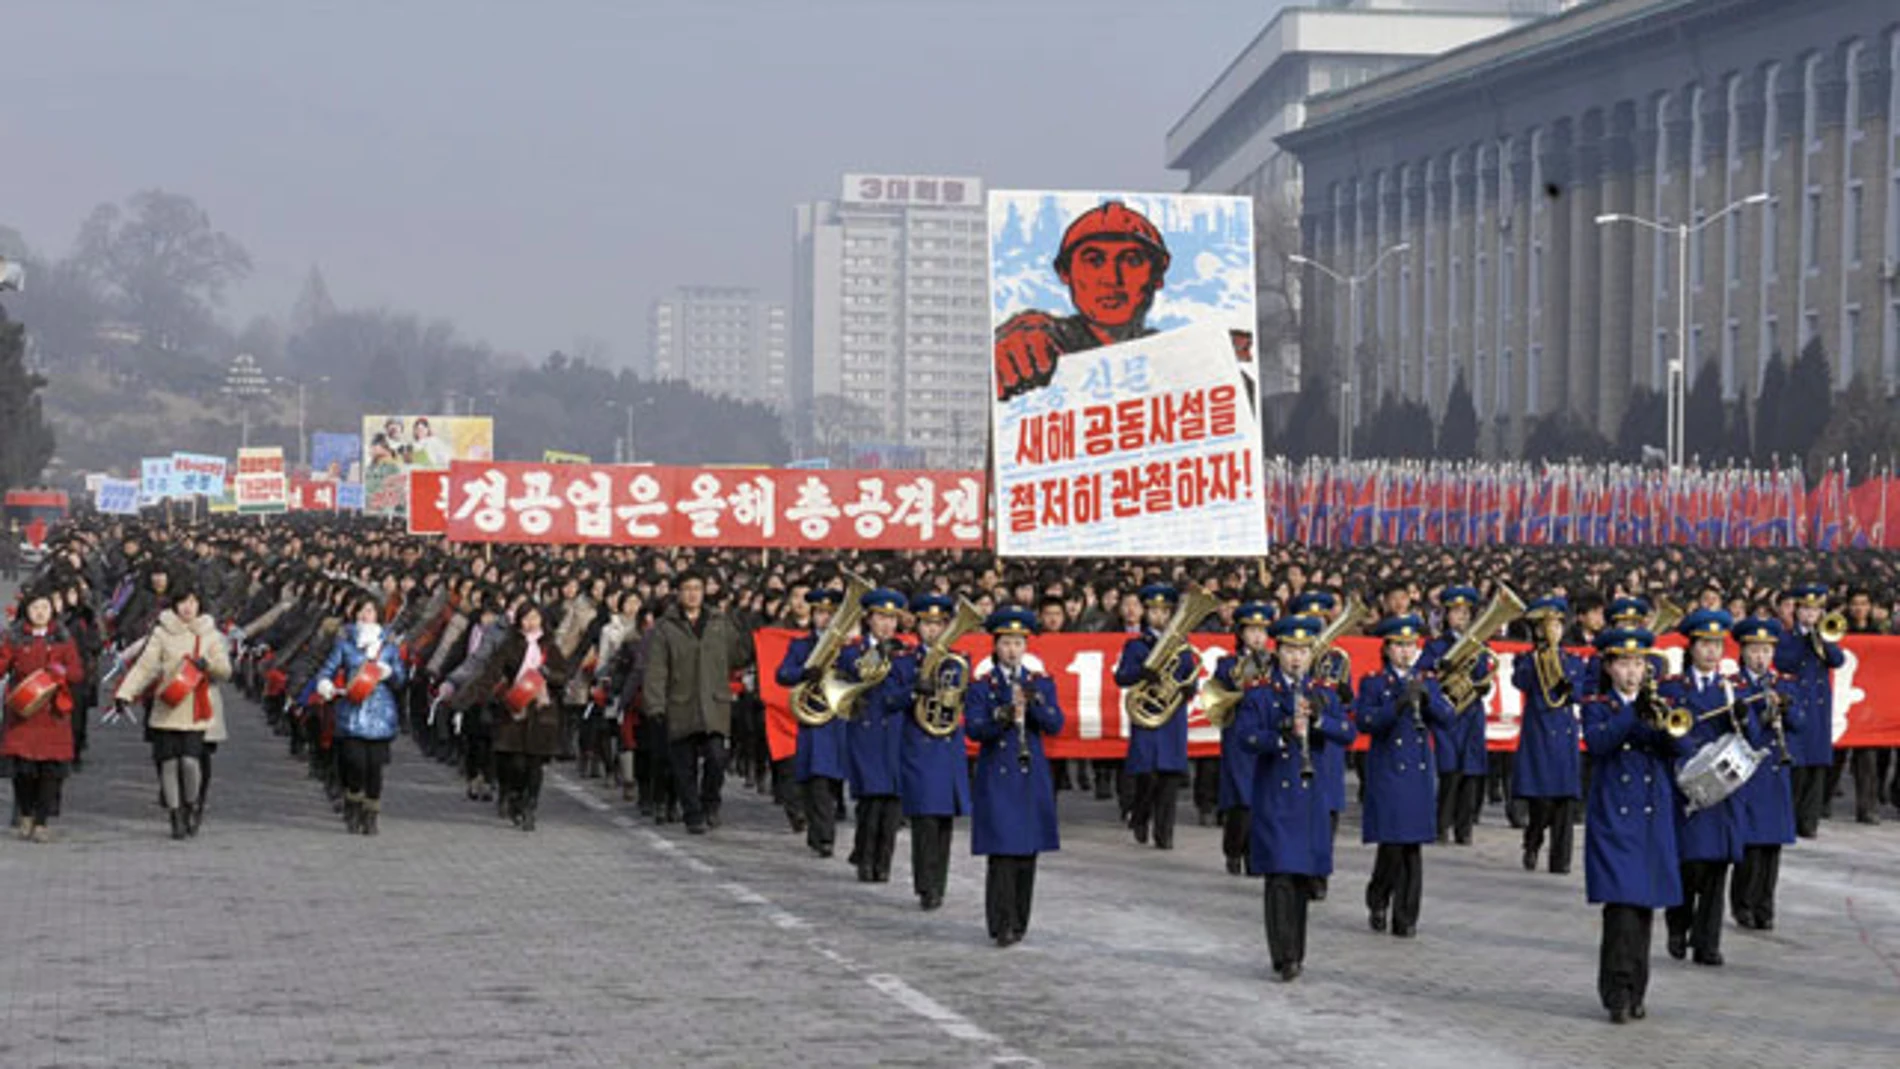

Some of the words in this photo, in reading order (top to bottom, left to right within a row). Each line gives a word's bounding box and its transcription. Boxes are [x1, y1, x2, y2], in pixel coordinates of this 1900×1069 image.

[1015, 409, 1076, 465] 새해
[1082, 384, 1237, 456] 공동사설을
[453, 468, 669, 538] 경공업은
[676, 473, 776, 539] 올해
[1010, 473, 1103, 534] 철저히
[1110, 449, 1254, 518] 관철하자!
